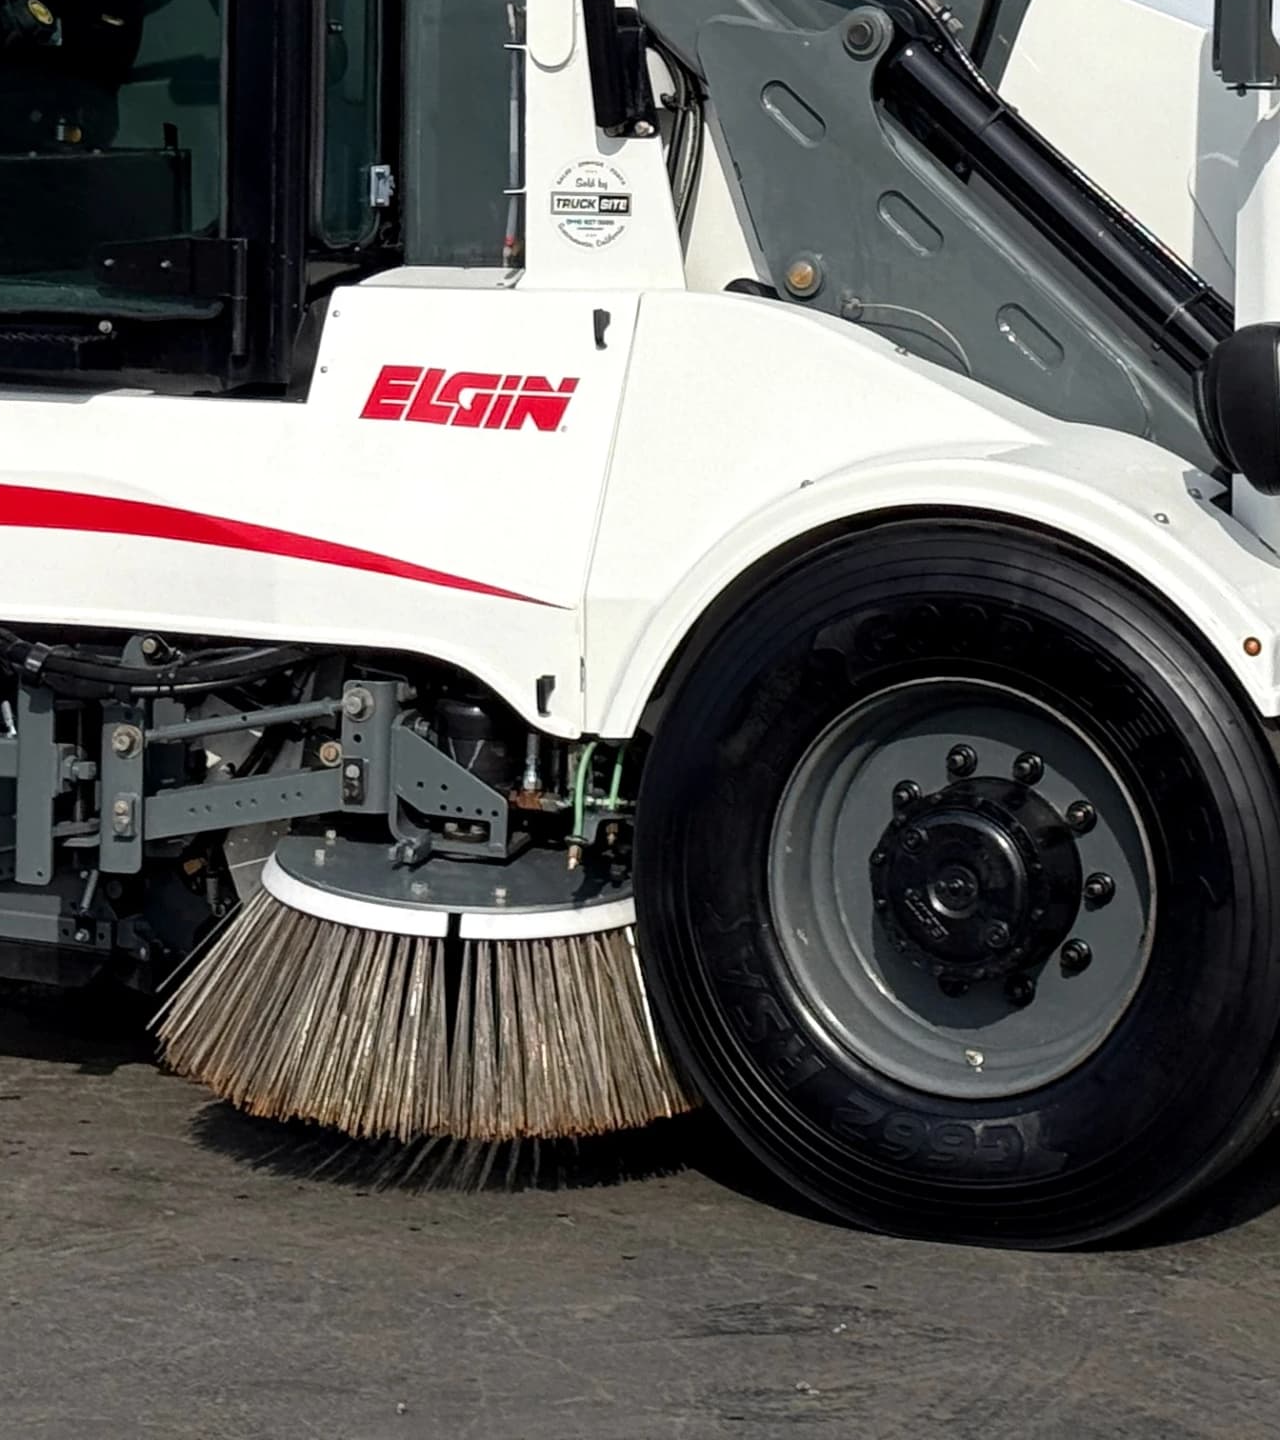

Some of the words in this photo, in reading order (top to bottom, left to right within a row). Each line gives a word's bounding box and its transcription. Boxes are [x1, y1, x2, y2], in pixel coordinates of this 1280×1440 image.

[575, 177, 595, 188] Sold
[598, 177, 608, 191] by
[556, 198, 597, 209] TRUCK
[600, 198, 627, 211] SITE
[358, 364, 581, 433] ELGIN
